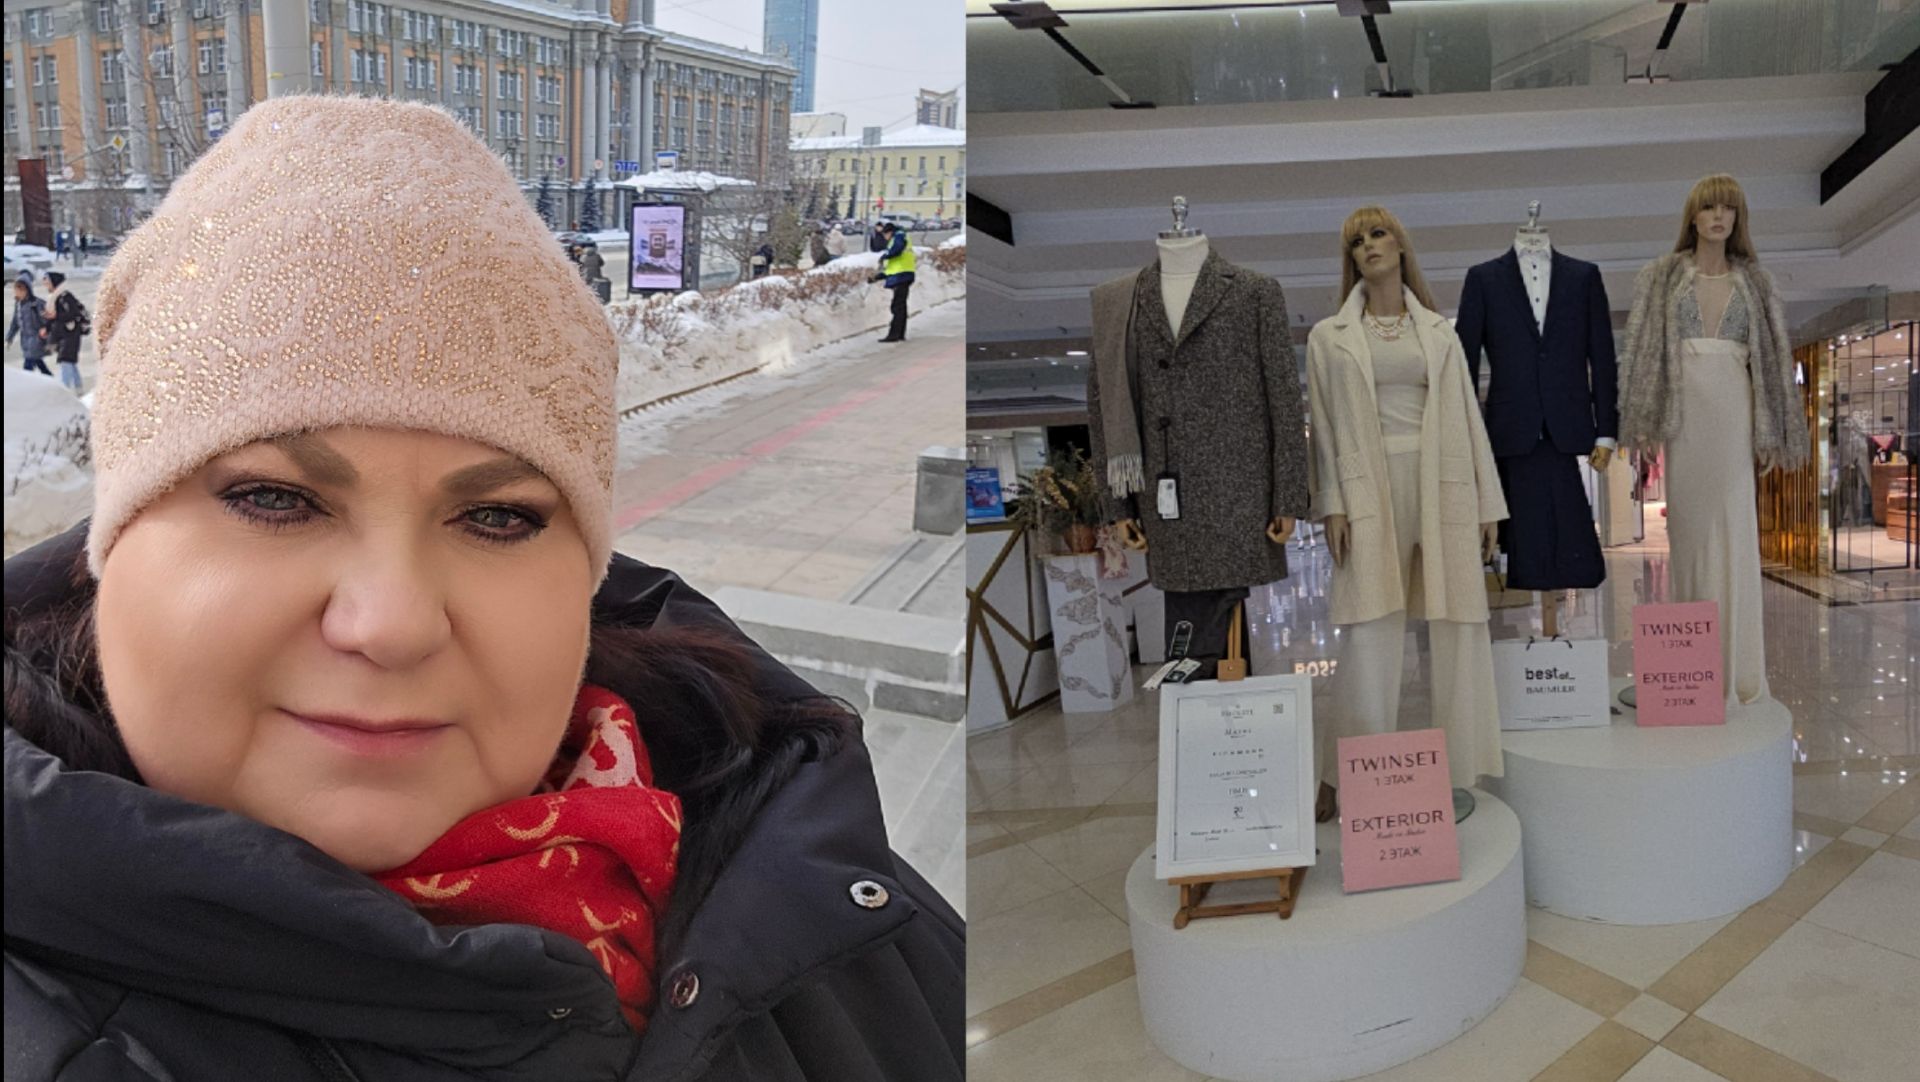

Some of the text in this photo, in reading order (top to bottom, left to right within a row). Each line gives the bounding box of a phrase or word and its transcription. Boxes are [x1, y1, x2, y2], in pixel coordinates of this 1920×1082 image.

[1639, 620, 1713, 636] TWINSET
[1524, 666, 1559, 680] best
[1642, 670, 1714, 684] EXTERIOR
[1347, 750, 1440, 773] TWINSET
[1384, 774, 1415, 786] ЭТАЖ
[1351, 809, 1445, 833] EXTERIOR
[1379, 845, 1422, 861] 2 ЭТАЖ
